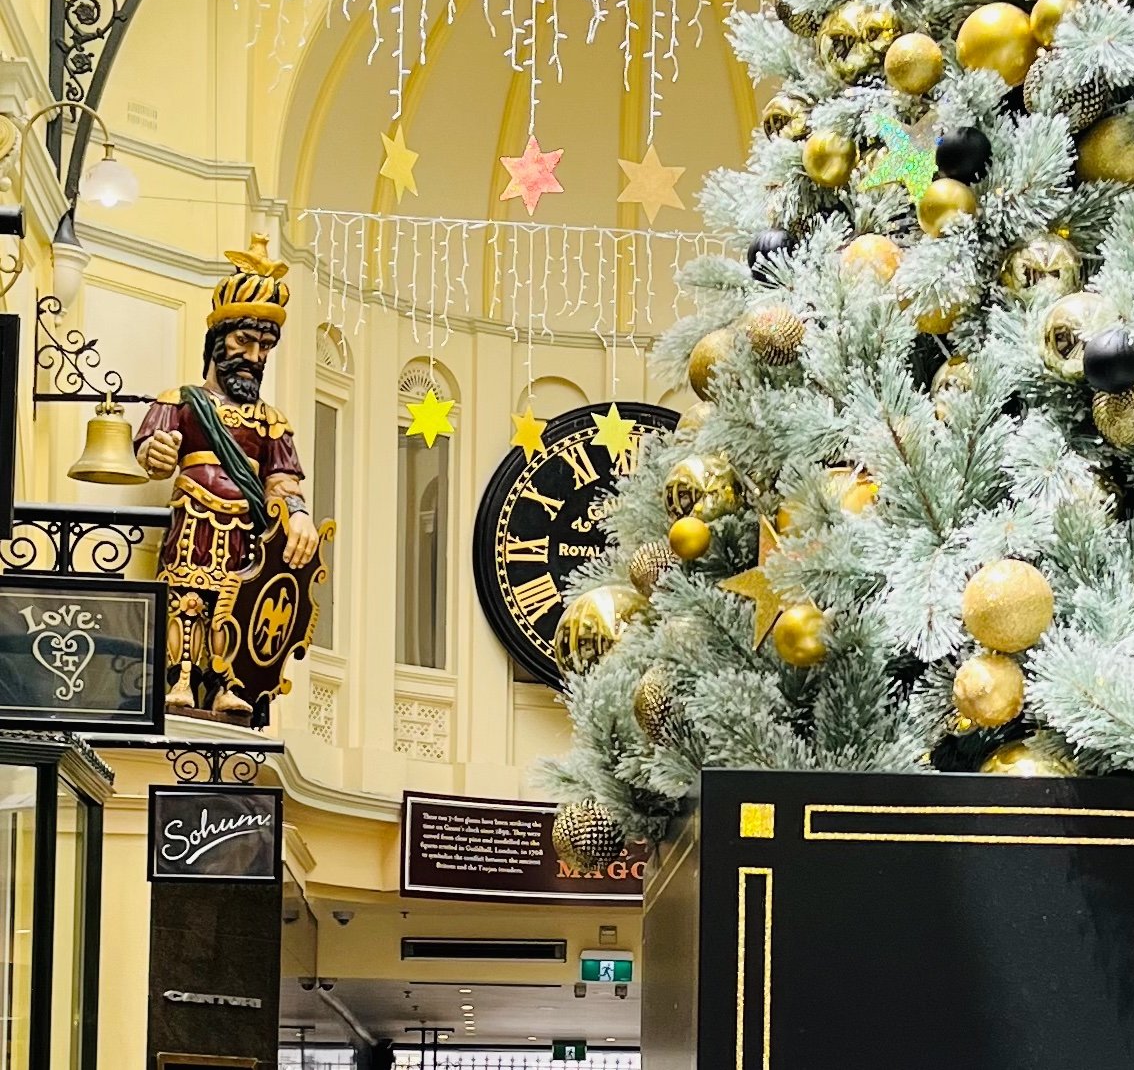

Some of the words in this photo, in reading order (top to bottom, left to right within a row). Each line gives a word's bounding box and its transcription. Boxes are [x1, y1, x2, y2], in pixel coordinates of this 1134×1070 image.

[559, 543, 602, 558] ROYAL
[51, 650, 79, 672] IT
[162, 808, 272, 861] Sohum
